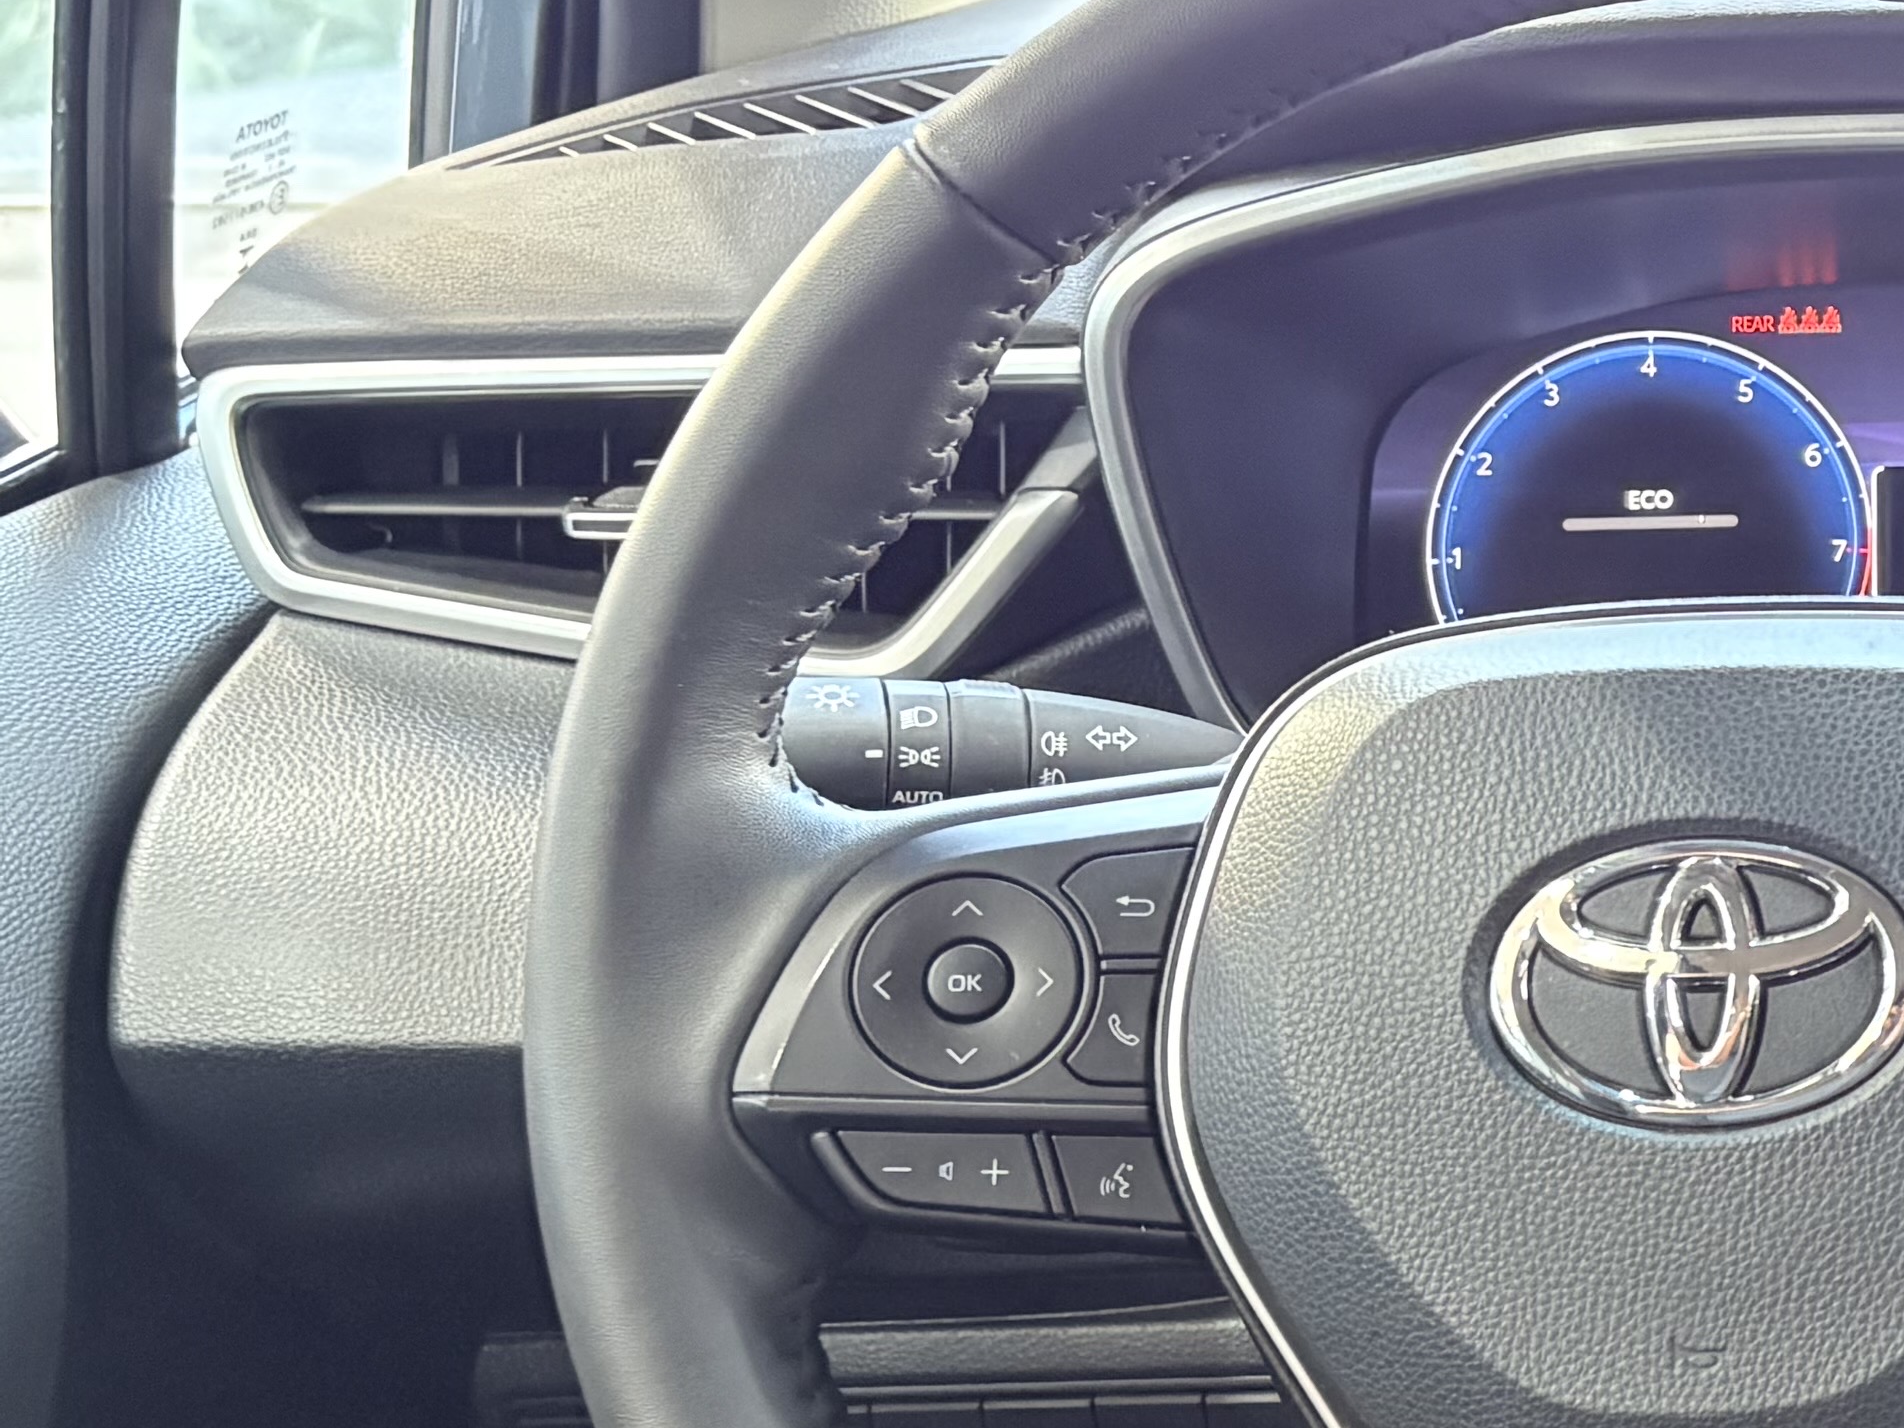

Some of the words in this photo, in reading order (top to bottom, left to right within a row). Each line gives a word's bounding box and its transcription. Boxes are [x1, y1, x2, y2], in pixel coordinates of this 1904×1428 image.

[1731, 315, 1775, 333] REAR
[1640, 353, 1658, 377] 4
[1544, 383, 1561, 406] 3
[1737, 380, 1754, 404] 5
[1476, 452, 1493, 476] 2
[1804, 443, 1823, 467] 6
[1625, 489, 1674, 511] ECO
[1452, 547, 1463, 570] 1
[1831, 539, 1849, 563] 7
[892, 790, 944, 803] AUTO
[947, 974, 983, 993] OK
